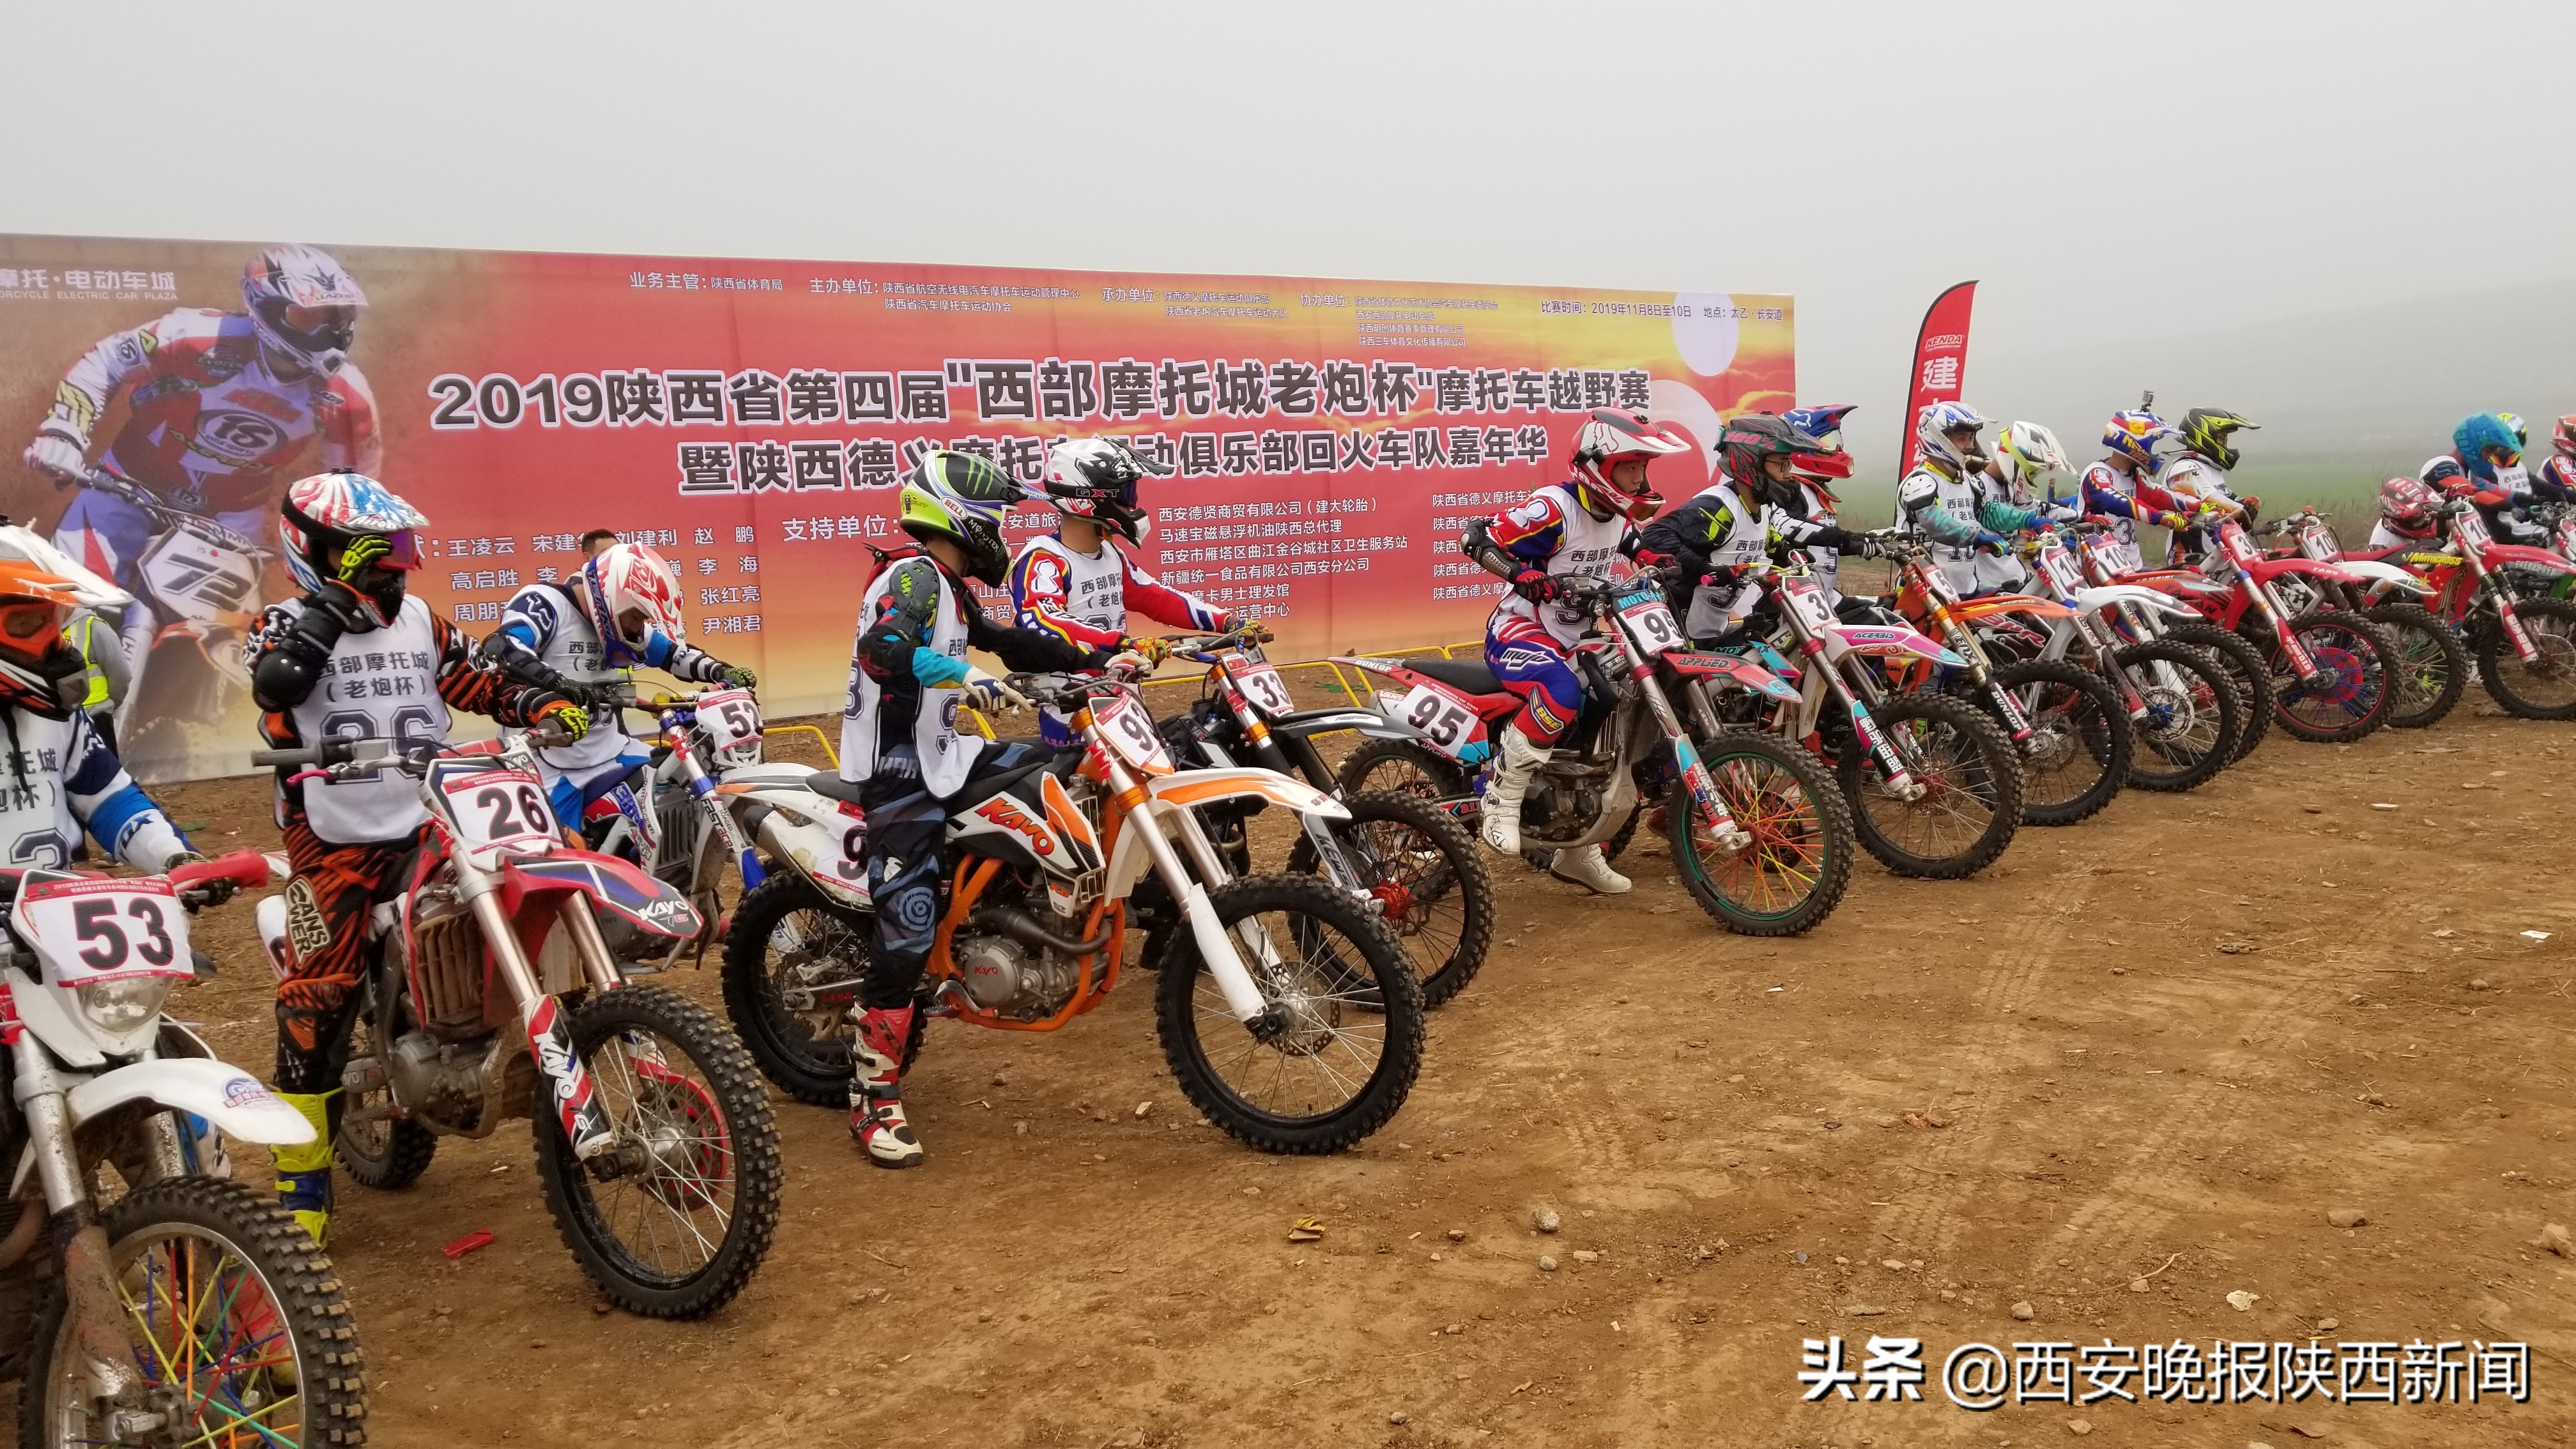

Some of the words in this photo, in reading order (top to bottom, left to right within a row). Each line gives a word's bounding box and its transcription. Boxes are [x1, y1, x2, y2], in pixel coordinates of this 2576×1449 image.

[57, 291, 109, 300] ELECTRIC
[1925, 335, 1963, 350] KENDA
[1724, 432, 1777, 450] 100%
[1076, 488, 1119, 498] GXT
[943, 498, 965, 519] BELL
[351, 513, 398, 530] Airoh
[1159, 519, 1342, 543] 马速宝磁悬浮机油陕西总代理
[448, 533, 516, 557] 王凌云
[1160, 535, 1407, 564] 西安市雁塔区曲江金谷城社区卫生服务站
[450, 568, 519, 591] 高启胜
[1160, 557, 1370, 586] 新疆统一食品有限公司西安分公司
[700, 585, 760, 605] 张红亮
[1184, 583, 1290, 603] 摩卡男士理发馆
[982, 604, 1016, 620] 商贸
[702, 614, 762, 635] 尹湘君
[569, 640, 604, 655] 西部
[1354, 659, 1392, 671] DUNLOP
[1677, 656, 1732, 669] APPLIED
[1379, 689, 1405, 702] VANS
[719, 701, 760, 739] 52
[1407, 694, 1469, 747] 95
[1991, 691, 2021, 731] DUNLOP
[477, 785, 549, 841] 26
[977, 797, 1055, 856] KAYO
[638, 900, 689, 921] KAYO
[72, 896, 175, 970] 53
[533, 1031, 577, 1100] KAYO
